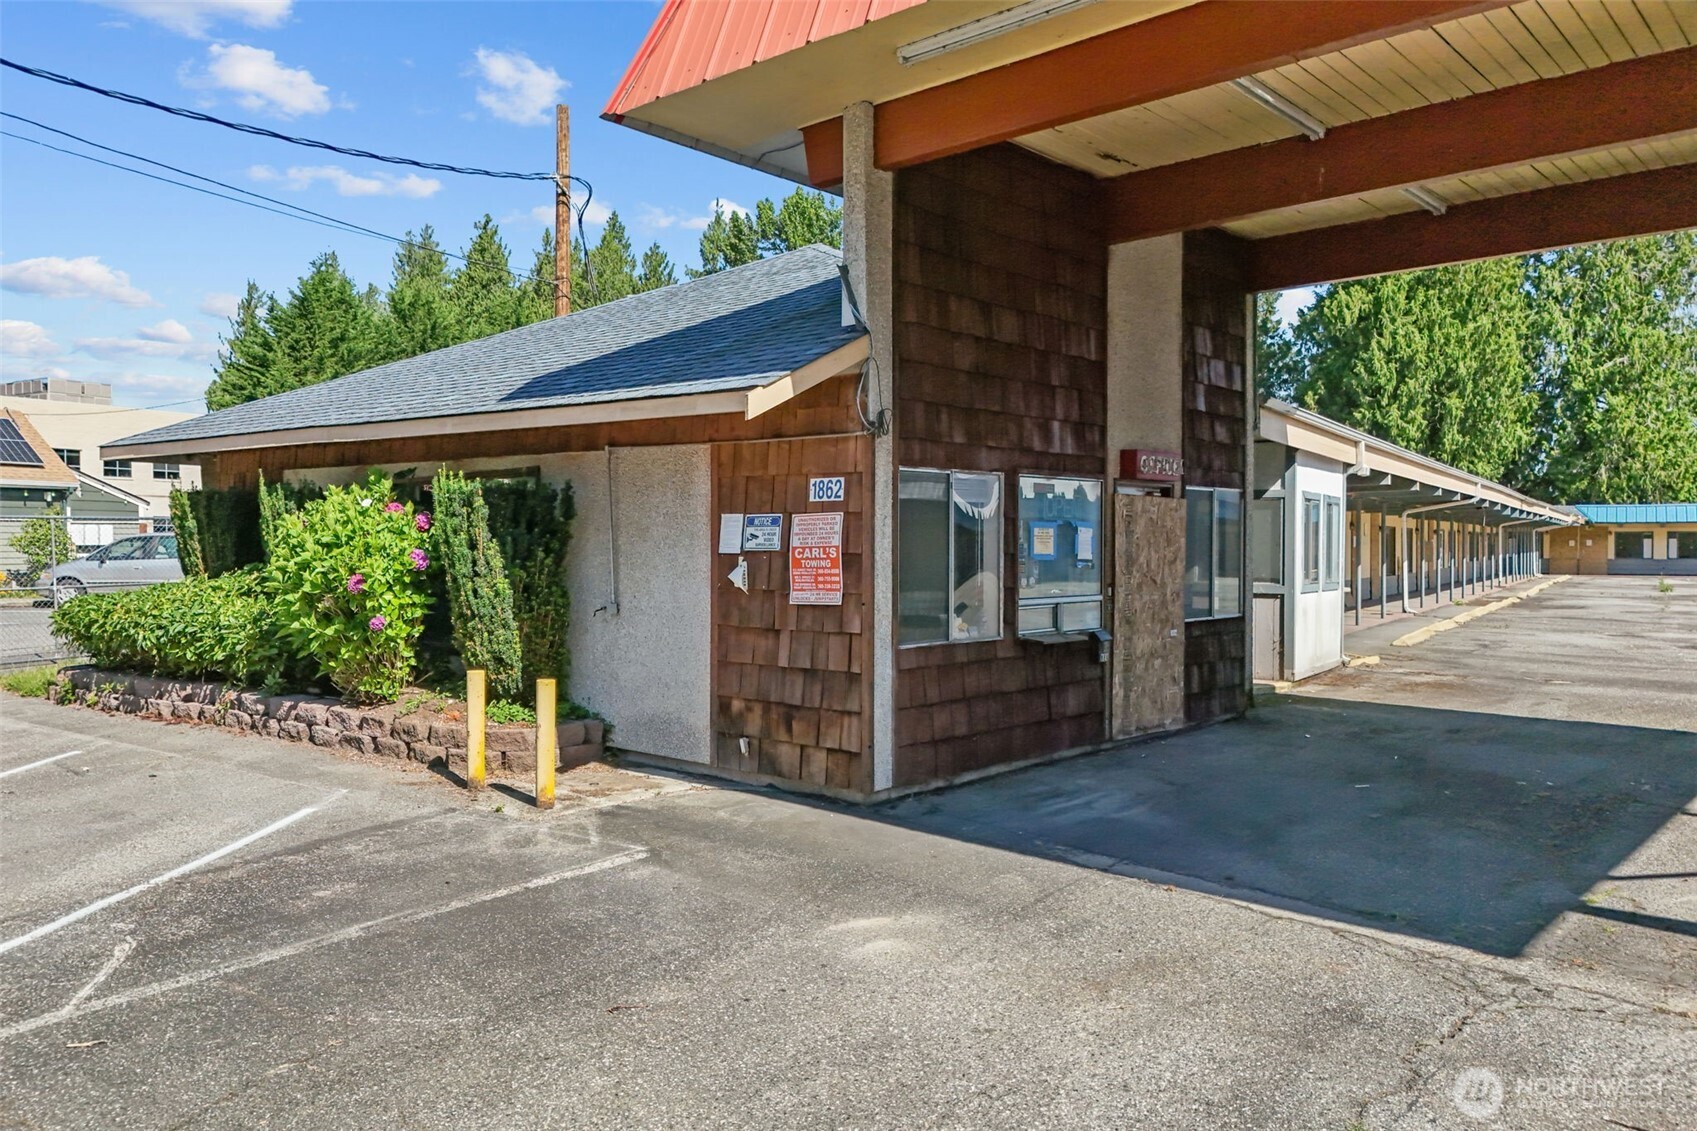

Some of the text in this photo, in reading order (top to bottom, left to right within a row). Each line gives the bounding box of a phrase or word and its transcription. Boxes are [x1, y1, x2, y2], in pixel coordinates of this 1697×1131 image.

[812, 479, 842, 500] 1862
[754, 517, 773, 526] NOTICE
[794, 547, 837, 558] CARL'S
[801, 560, 831, 568] TOWING
